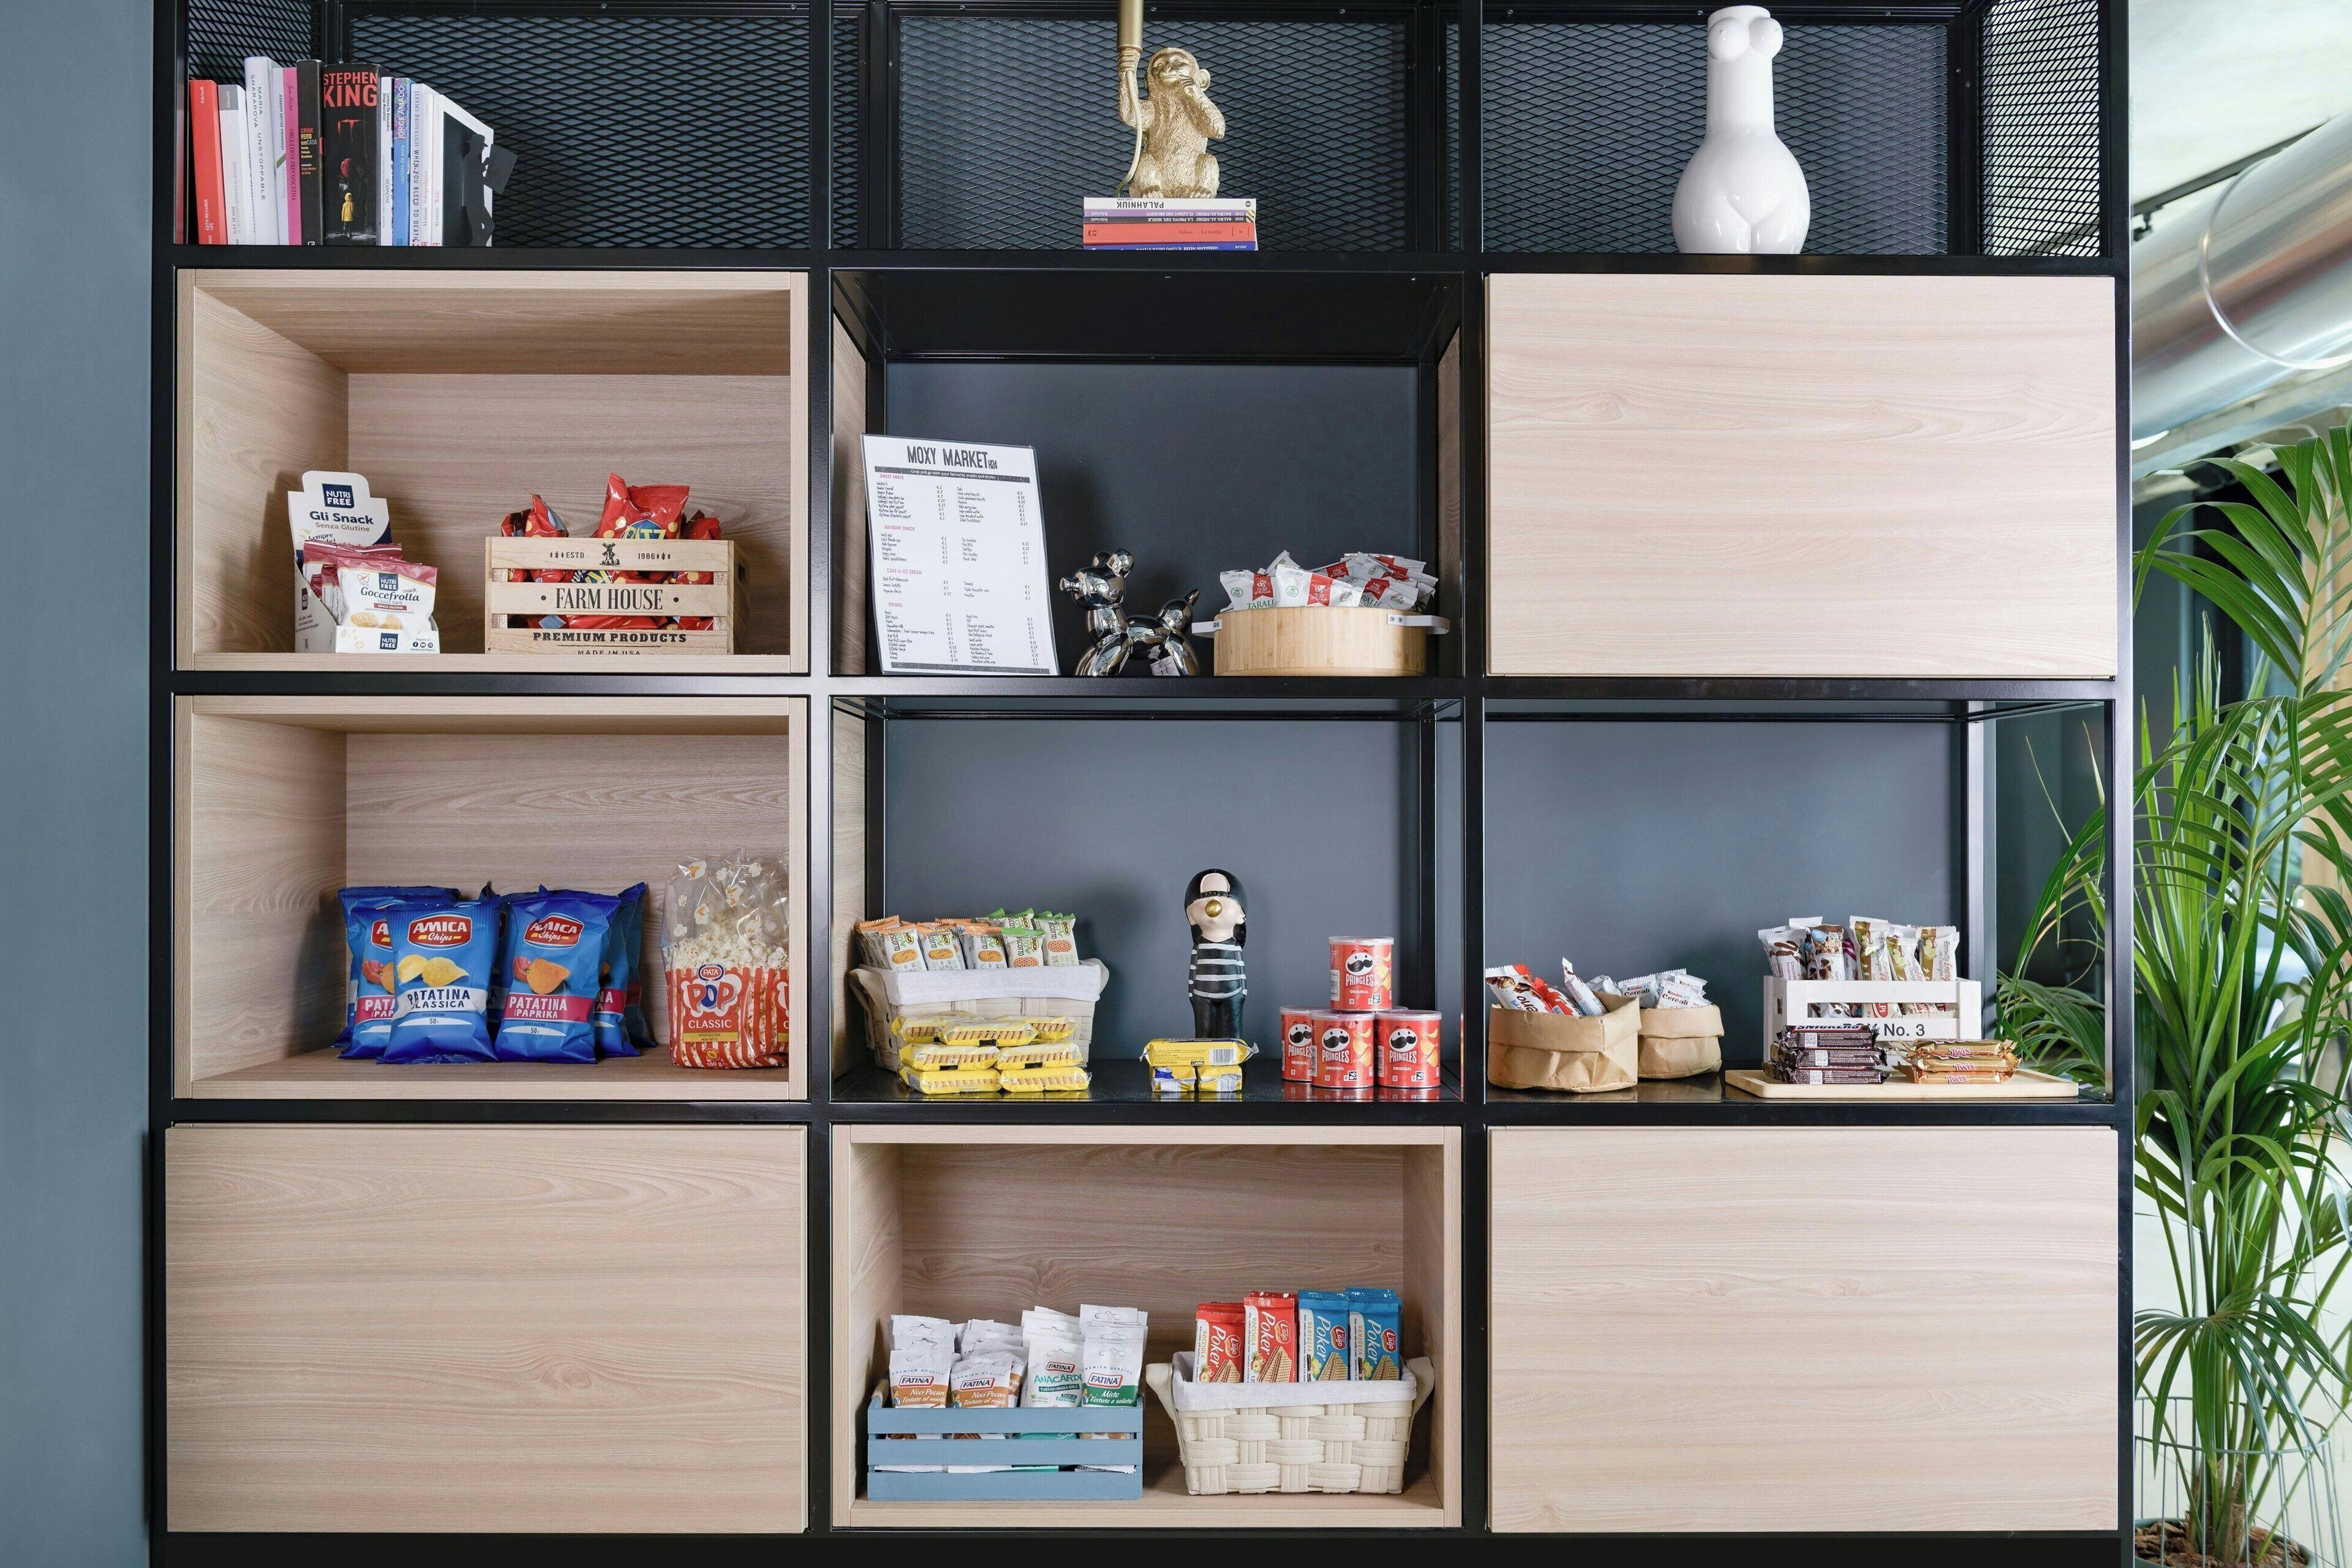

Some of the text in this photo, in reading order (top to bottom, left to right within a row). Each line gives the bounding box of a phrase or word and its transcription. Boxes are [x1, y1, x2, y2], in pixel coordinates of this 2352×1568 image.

[323, 72, 377, 86] STEPHEN
[323, 84, 377, 108] KING
[337, 119, 361, 143] IT
[907, 445, 998, 469] MOXY MARKET H24
[309, 511, 374, 524] Gli Snack
[622, 526, 666, 540] RITZ
[360, 587, 420, 601] Goccefrolla
[556, 587, 663, 610] FARM HOUSE
[532, 631, 687, 643] PREMIUM PRODUCTS
[413, 921, 467, 933] AMICA
[532, 922, 578, 933] AMICA
[427, 932, 453, 942] Chips
[537, 931, 562, 941] Chips
[1940, 962, 1953, 981] Energ
[1346, 973, 1374, 987] PRINGLES
[407, 988, 470, 1005] PATATINA
[687, 981, 734, 1011] POP
[1662, 993, 1689, 1006] Cereali
[509, 996, 567, 1011] PATATINA
[516, 1009, 558, 1019] PAPRIKA
[688, 1019, 732, 1028] CLASSIC
[1883, 1023, 1910, 1036] No.
[1916, 1024, 1925, 1036] 3
[1288, 1044, 1312, 1058] PRINGLES
[1322, 1050, 1349, 1063] PRINGLES
[1389, 1050, 1417, 1064] PRINGLES
[1948, 1046, 1971, 1057] Twix
[1953, 1061, 1976, 1072] Twix
[1945, 1074, 1969, 1084] Twix
[1260, 1311, 1276, 1355] Poker
[1280, 1323, 1289, 1341] Lago
[1316, 1315, 1331, 1361] Poker
[1335, 1328, 1344, 1347] Lago
[1210, 1325, 1226, 1368] Poker
[1231, 1337, 1239, 1355] Lago
[1367, 1319, 1382, 1364] Poker
[1386, 1332, 1395, 1350] Lago
[1034, 1374, 1082, 1384] ANACARDI
[1090, 1376, 1118, 1385] FATINA
